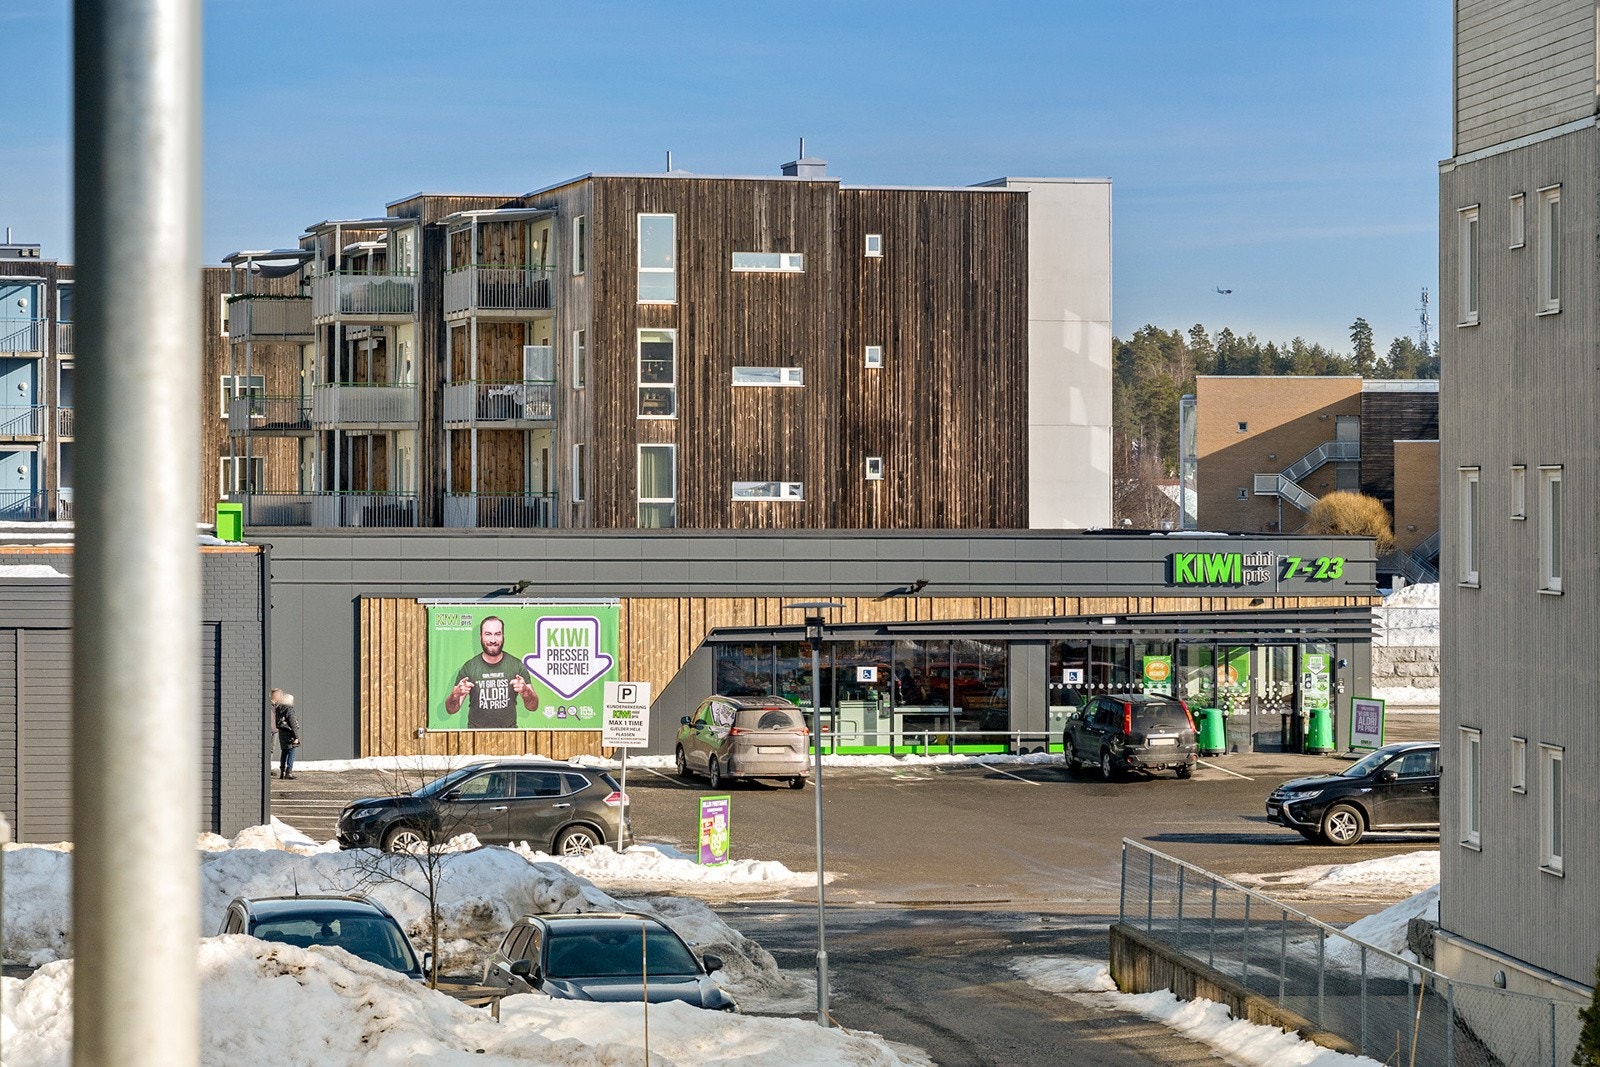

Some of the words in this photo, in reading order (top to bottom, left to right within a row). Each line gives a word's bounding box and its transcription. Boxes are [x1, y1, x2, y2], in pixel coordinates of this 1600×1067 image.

[1175, 552, 1242, 583] KIWI
[1243, 551, 1273, 566] mini
[1243, 567, 1270, 586] pris
[435, 613, 460, 626] KIWI
[547, 628, 589, 647] KIWI
[547, 649, 589, 661] PRESSER
[547, 663, 589, 675] PRISENE!
[486, 679, 496, 688] GIR
[497, 679, 509, 687] OSS
[479, 688, 508, 700] ALDRI
[622, 688, 632, 700] P
[613, 710, 631, 719] KIWI
[1358, 716, 1378, 727] ALDRI
